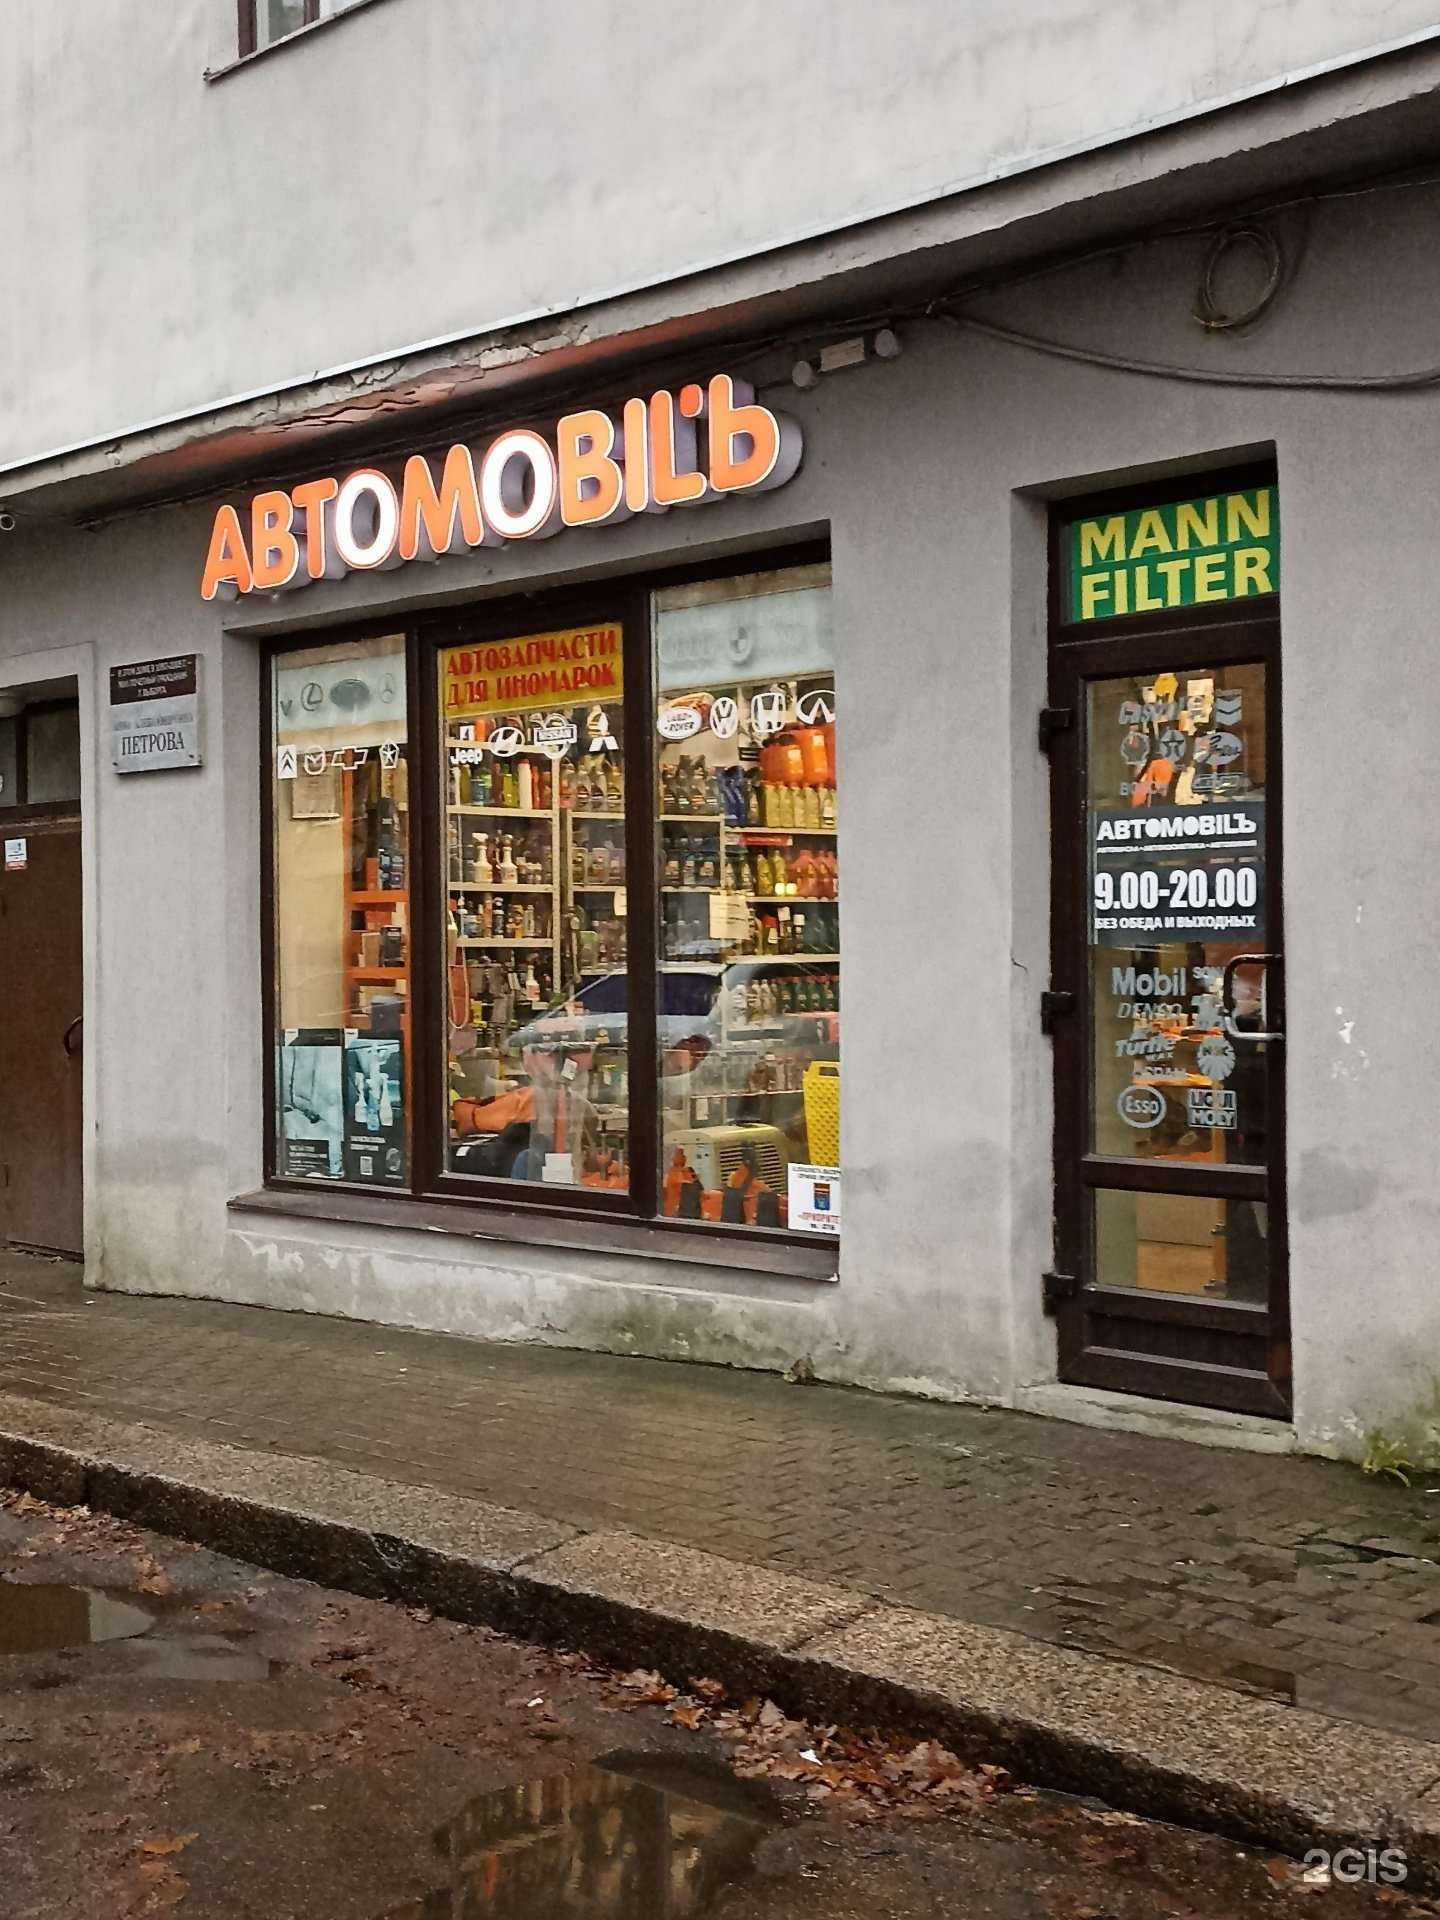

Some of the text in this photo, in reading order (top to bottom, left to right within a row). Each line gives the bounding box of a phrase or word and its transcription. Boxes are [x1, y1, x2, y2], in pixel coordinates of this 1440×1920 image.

[1080, 490, 1270, 567] MANN
[1081, 547, 1273, 619] FILTER
[448, 630, 617, 676] АВТОЗАПЧАСТИ
[448, 662, 616, 707] ДЛЯ ИНОМАРОК
[122, 731, 185, 756] ПЕТРОВА
[450, 747, 483, 765] Jeep
[1094, 867, 1257, 911] 9.00-20.00
[1095, 915, 1257, 931] БЕЗ ОБЕДА И ВЫХОДНЫХ
[1112, 967, 1186, 996] Mobil
